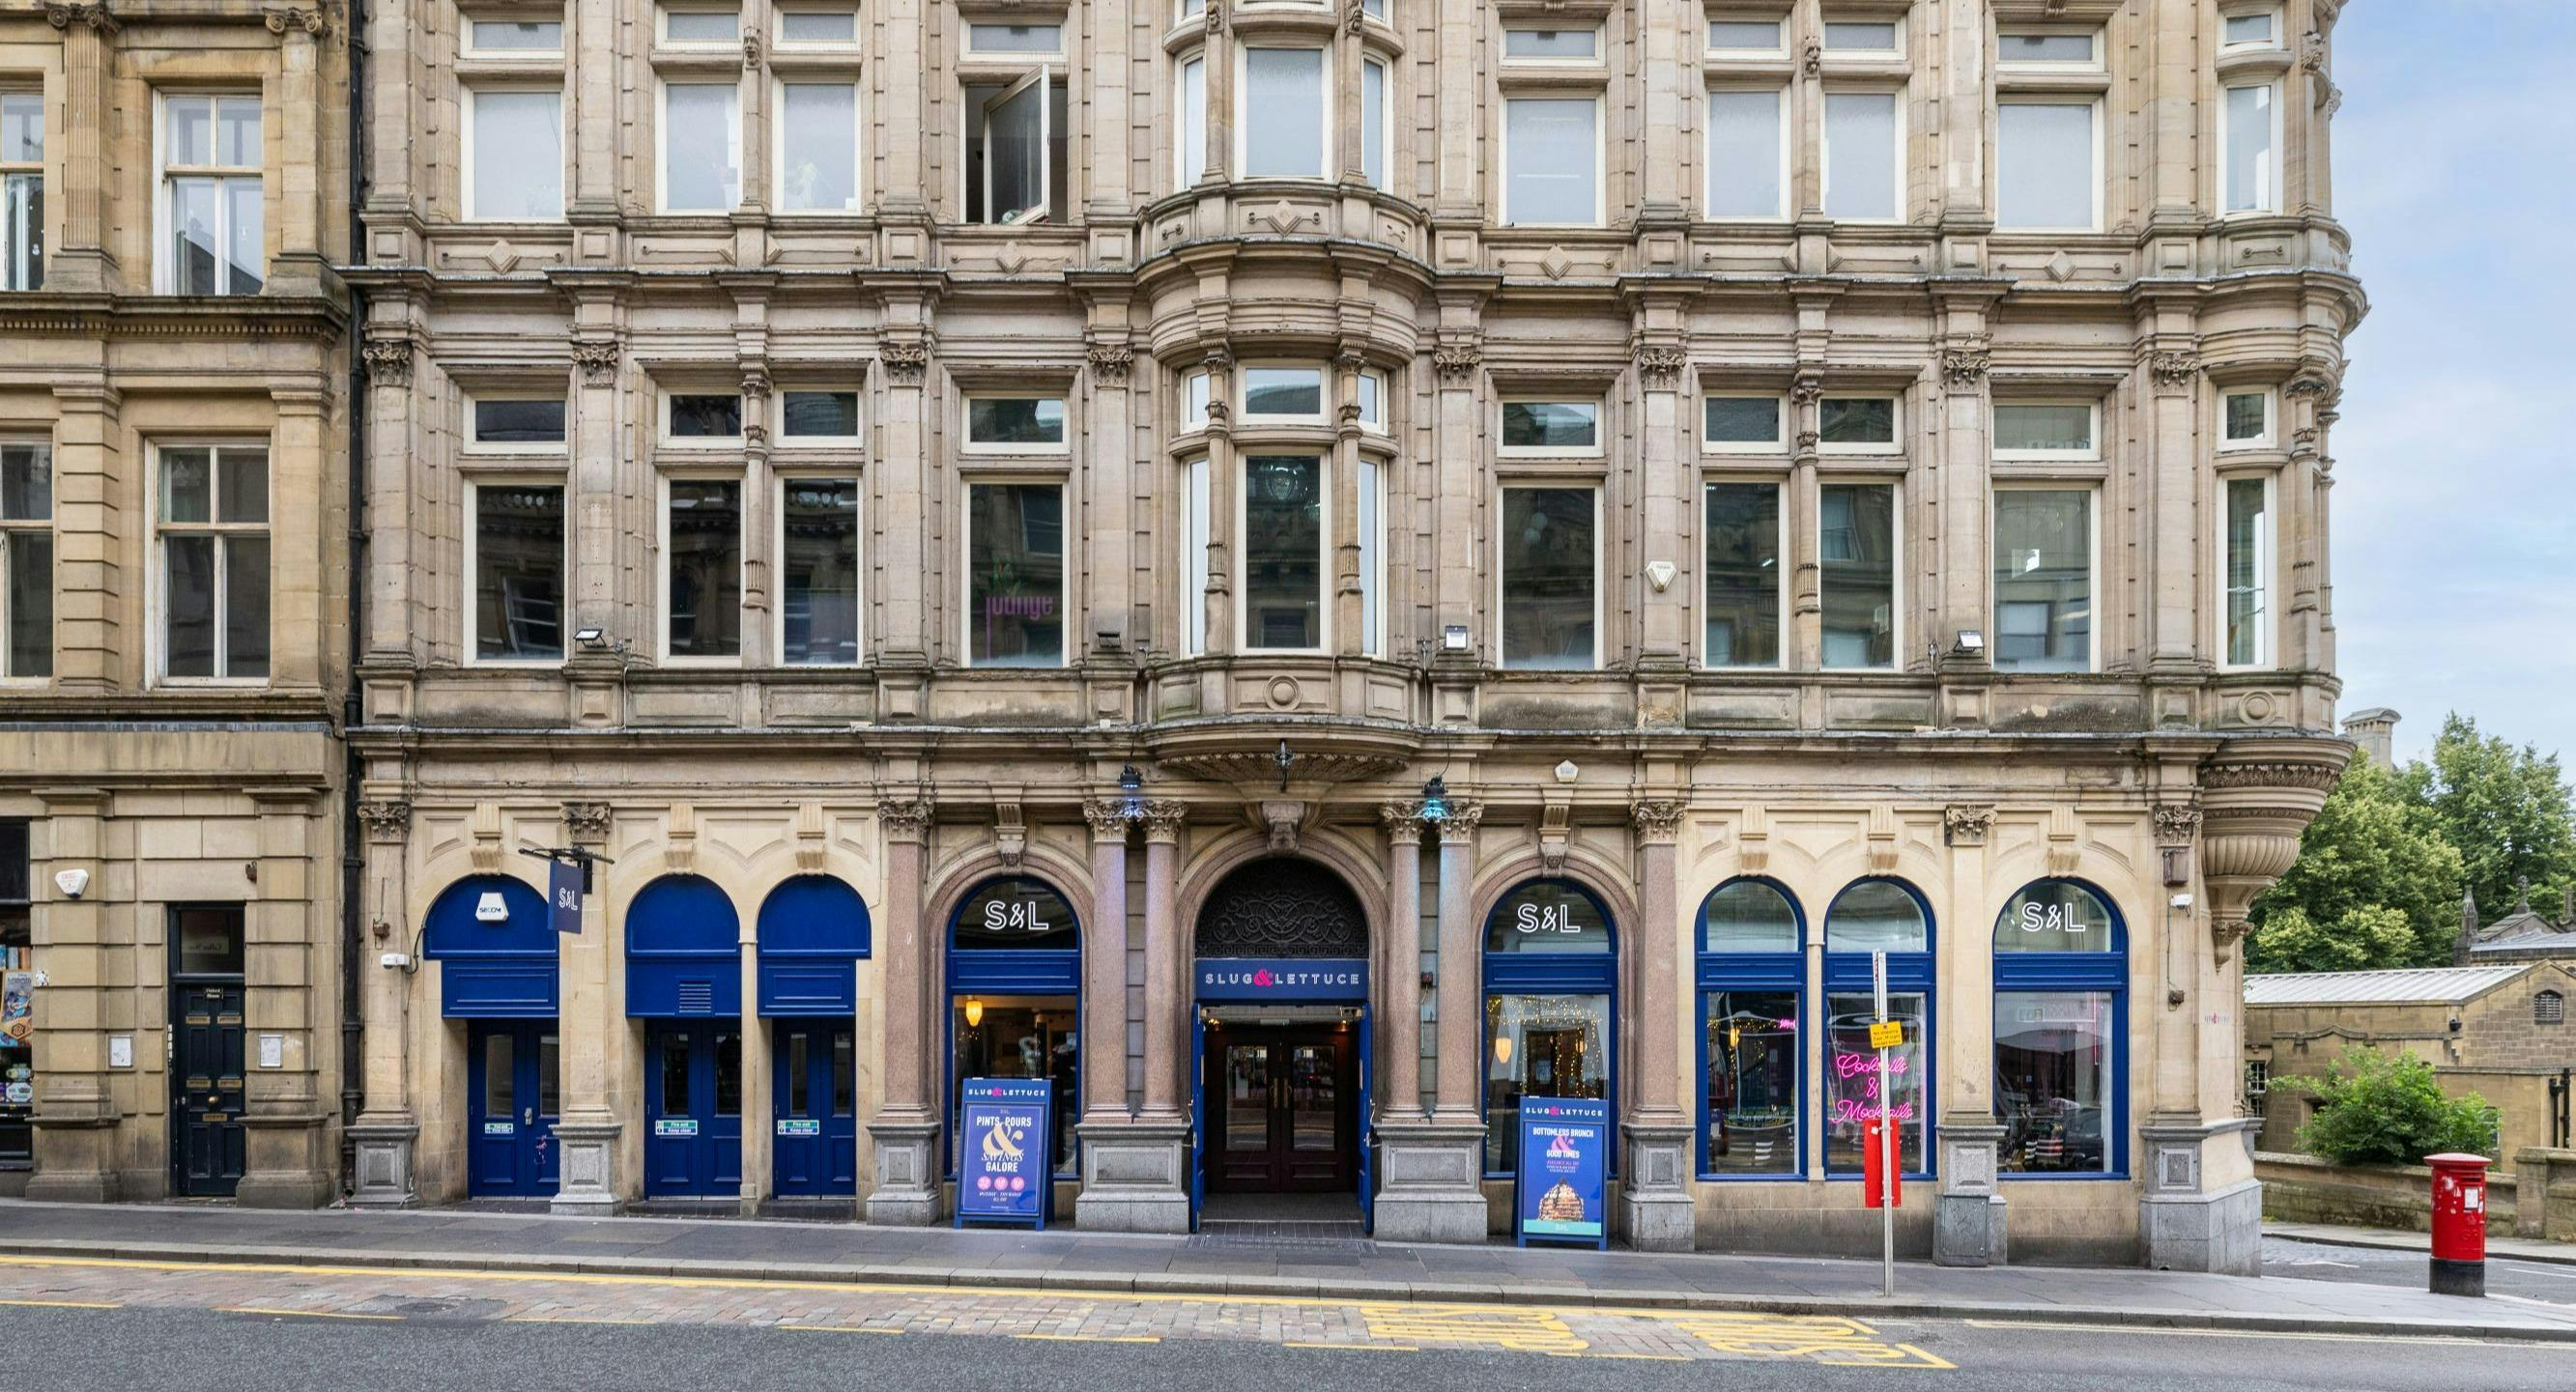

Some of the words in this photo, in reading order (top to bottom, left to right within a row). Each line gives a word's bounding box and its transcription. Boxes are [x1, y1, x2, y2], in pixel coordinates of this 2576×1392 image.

[558, 887, 578, 911] S&L
[984, 899, 1049, 930] S&L
[1516, 902, 1581, 933] S&L
[2020, 901, 2086, 932] S&L
[1205, 973, 1252, 984] SLUG
[1274, 973, 1360, 984] LETTUCE
[1837, 1054, 1908, 1078] Cockils
[968, 1088, 991, 1096] SLUG
[1866, 1076, 1879, 1099] &
[1005, 1116, 1032, 1127] POURS
[1560, 1108, 1603, 1117] LETTUCE
[1831, 1099, 1913, 1124] Mockails
[982, 1121, 1024, 1158] &
[1532, 1126, 1570, 1137] BOTTOMLESS
[1570, 1128, 1594, 1138] BRUNCH
[1546, 1150, 1562, 1158] GOOD
[1562, 1150, 1580, 1158] TIMES
[986, 1161, 1018, 1173] GALORE
[1358, 1306, 1591, 1352] STOP
[1674, 1321, 1906, 1358] BUS
